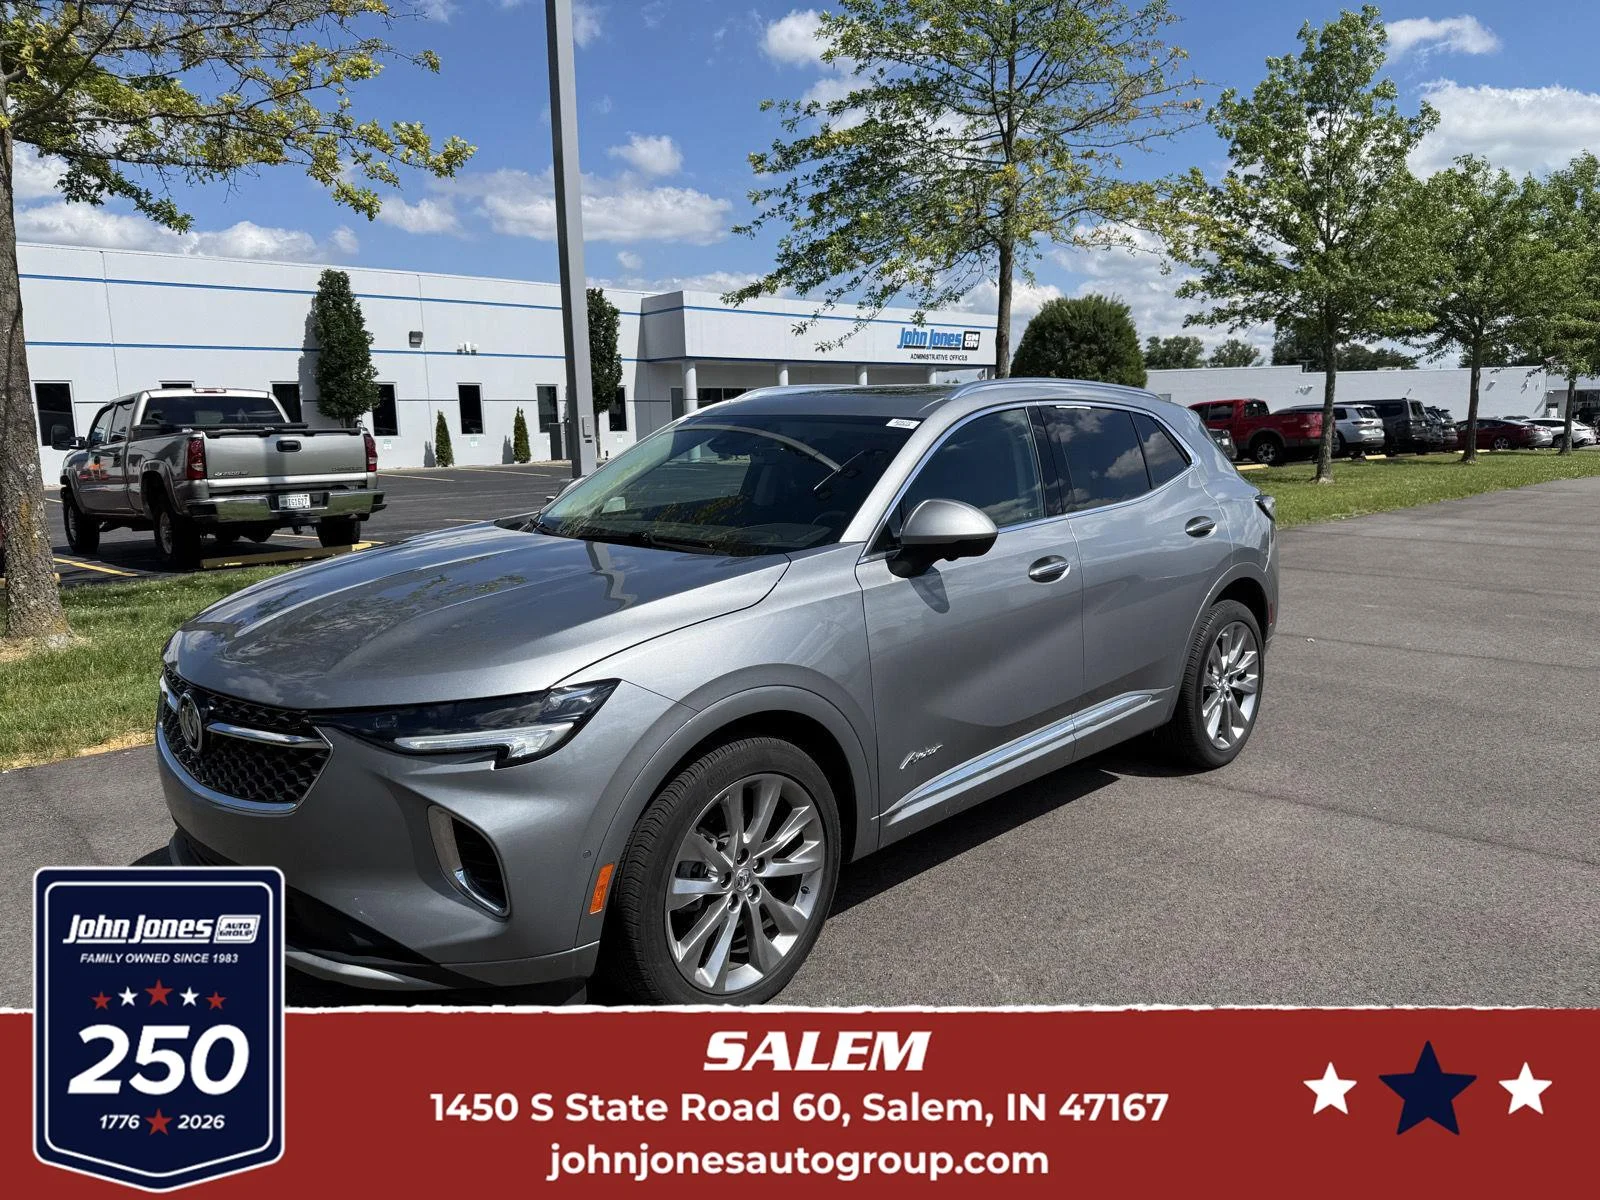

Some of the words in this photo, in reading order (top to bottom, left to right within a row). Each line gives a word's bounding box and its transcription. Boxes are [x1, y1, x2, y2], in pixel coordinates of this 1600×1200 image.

[897, 327, 928, 349] John
[926, 329, 962, 350] Jones
[910, 353, 948, 361] ADMINISTRATIVE
[949, 354, 968, 362] OFFICES
